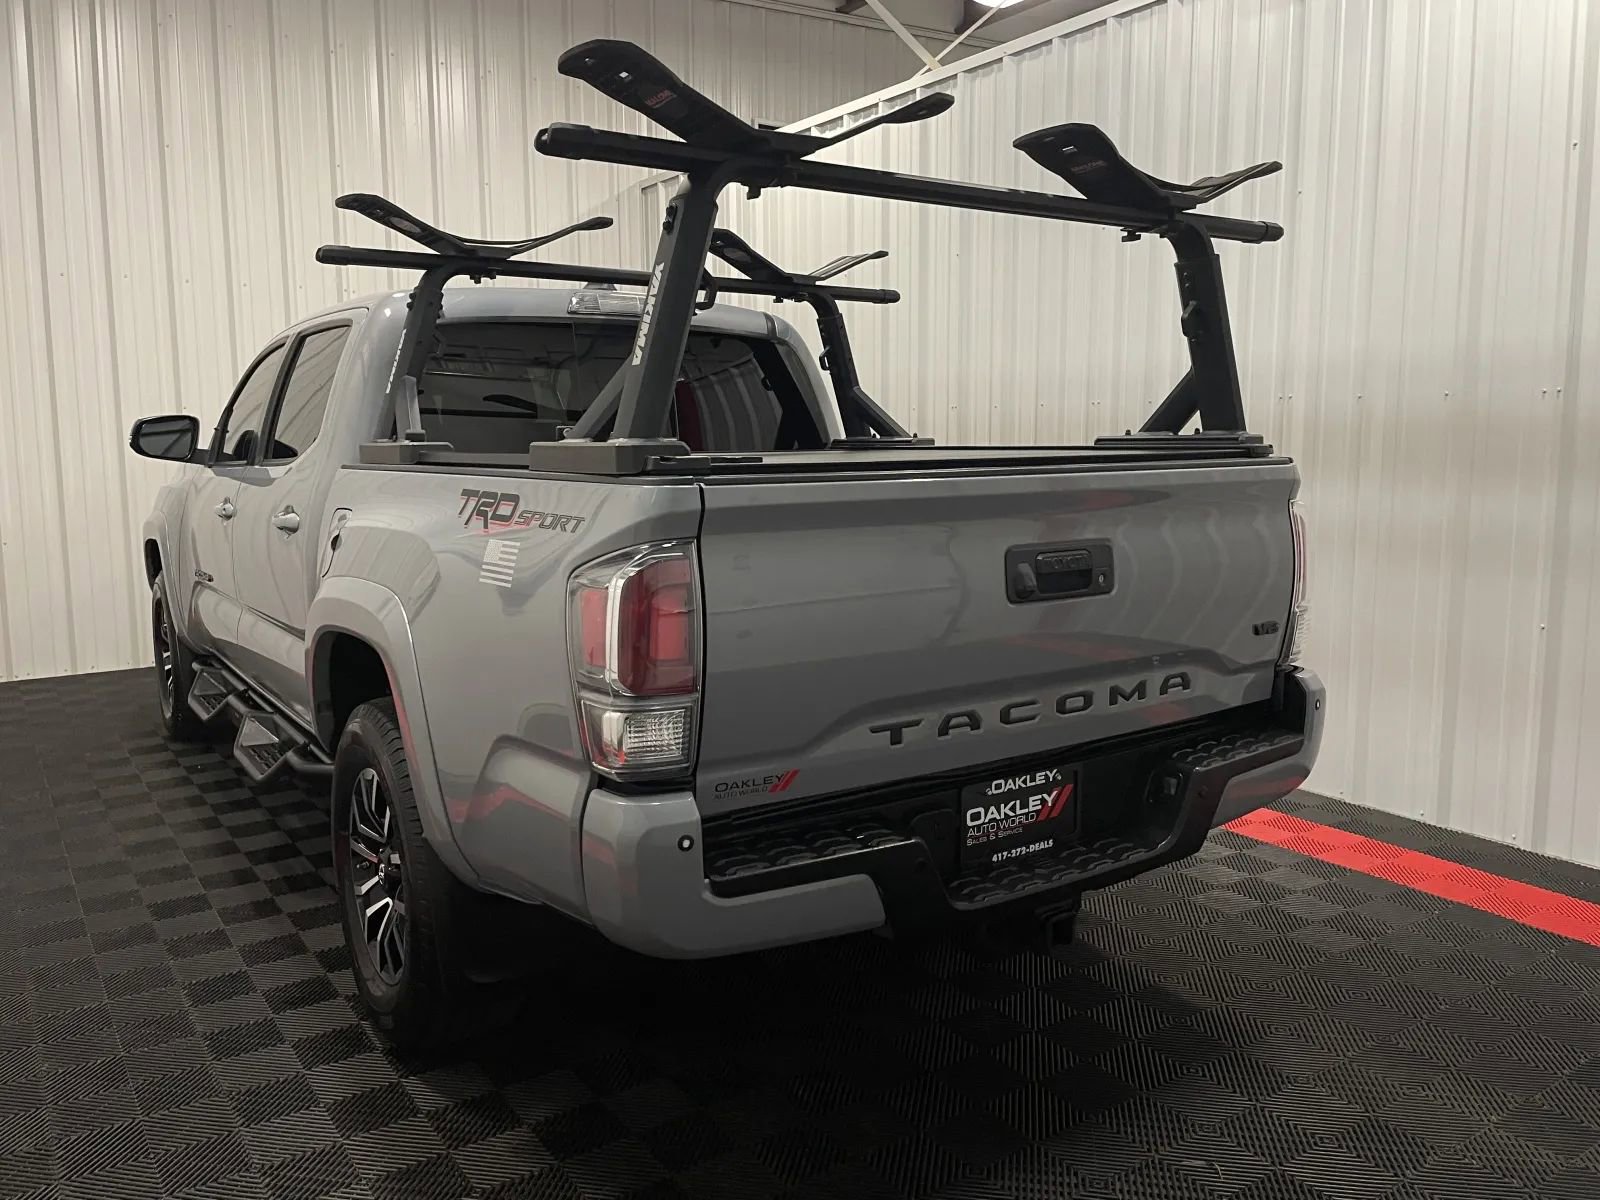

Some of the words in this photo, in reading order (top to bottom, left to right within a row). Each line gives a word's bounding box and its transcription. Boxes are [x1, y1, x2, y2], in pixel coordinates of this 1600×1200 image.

[631, 262, 664, 366] YAKIMA
[458, 488, 520, 533] TRD
[514, 509, 585, 534] SPORT
[869, 671, 1192, 746] TACOMA
[714, 774, 785, 792] OAKLEY
[991, 768, 1058, 795] OAKLEY
[966, 790, 1059, 827] OAKLEY
[967, 822, 998, 838] AUTO
[998, 812, 1037, 829] WORLD
[992, 839, 1054, 862] 417-272-DEALS
